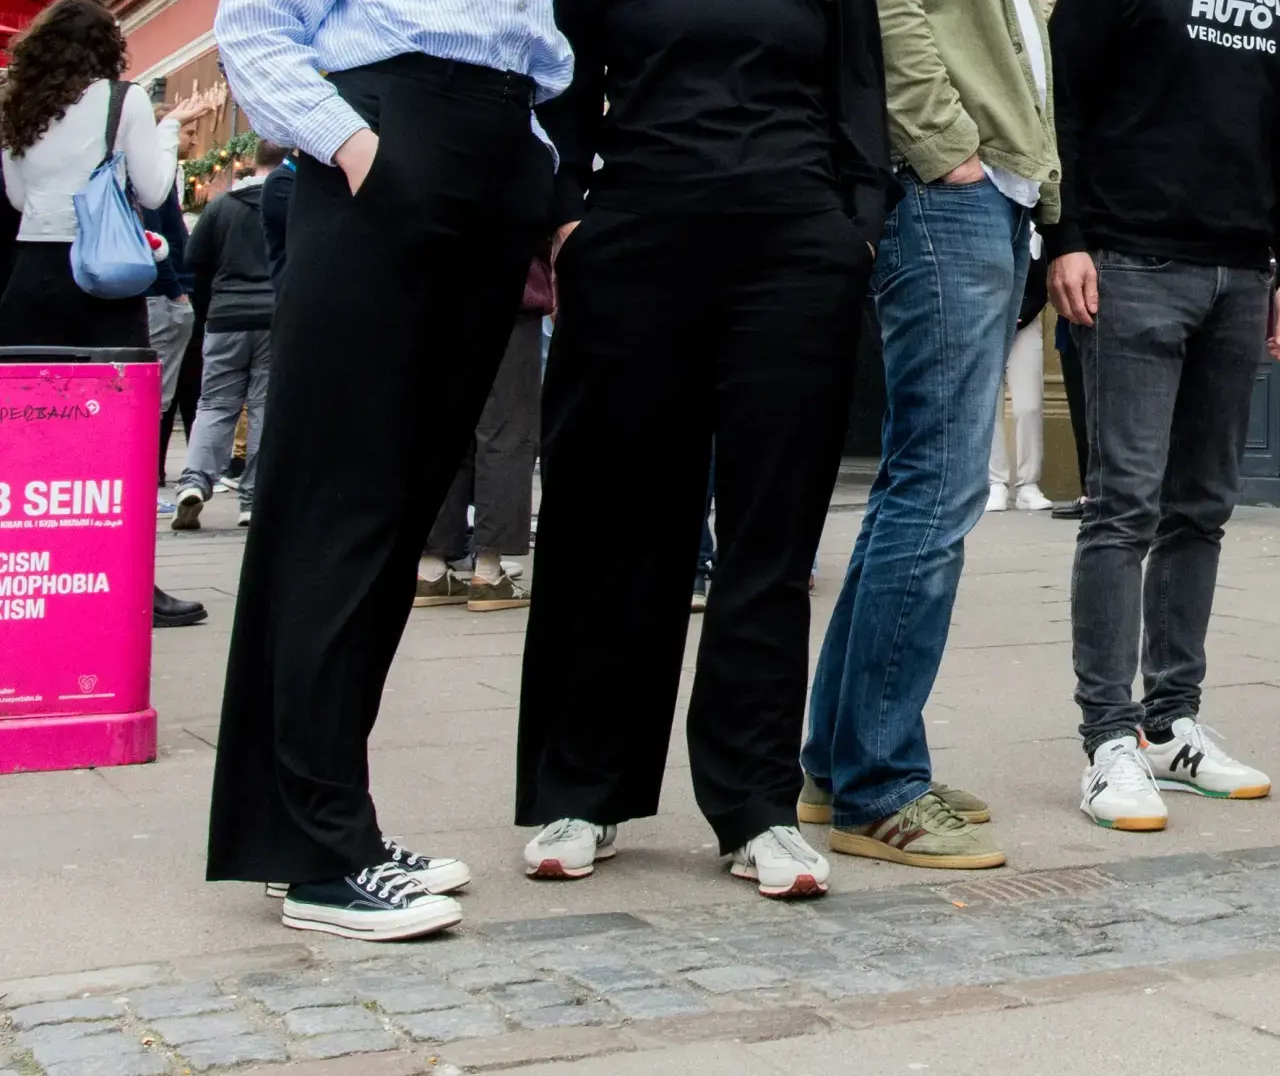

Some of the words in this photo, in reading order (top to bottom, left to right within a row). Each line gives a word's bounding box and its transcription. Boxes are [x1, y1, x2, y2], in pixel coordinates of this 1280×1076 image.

[1186, 24, 1277, 54] VERLOSUNG
[23, 479, 123, 517] SEIN!
[0, 572, 110, 597] MOPHOBIA
[0, 598, 45, 621] ISM
